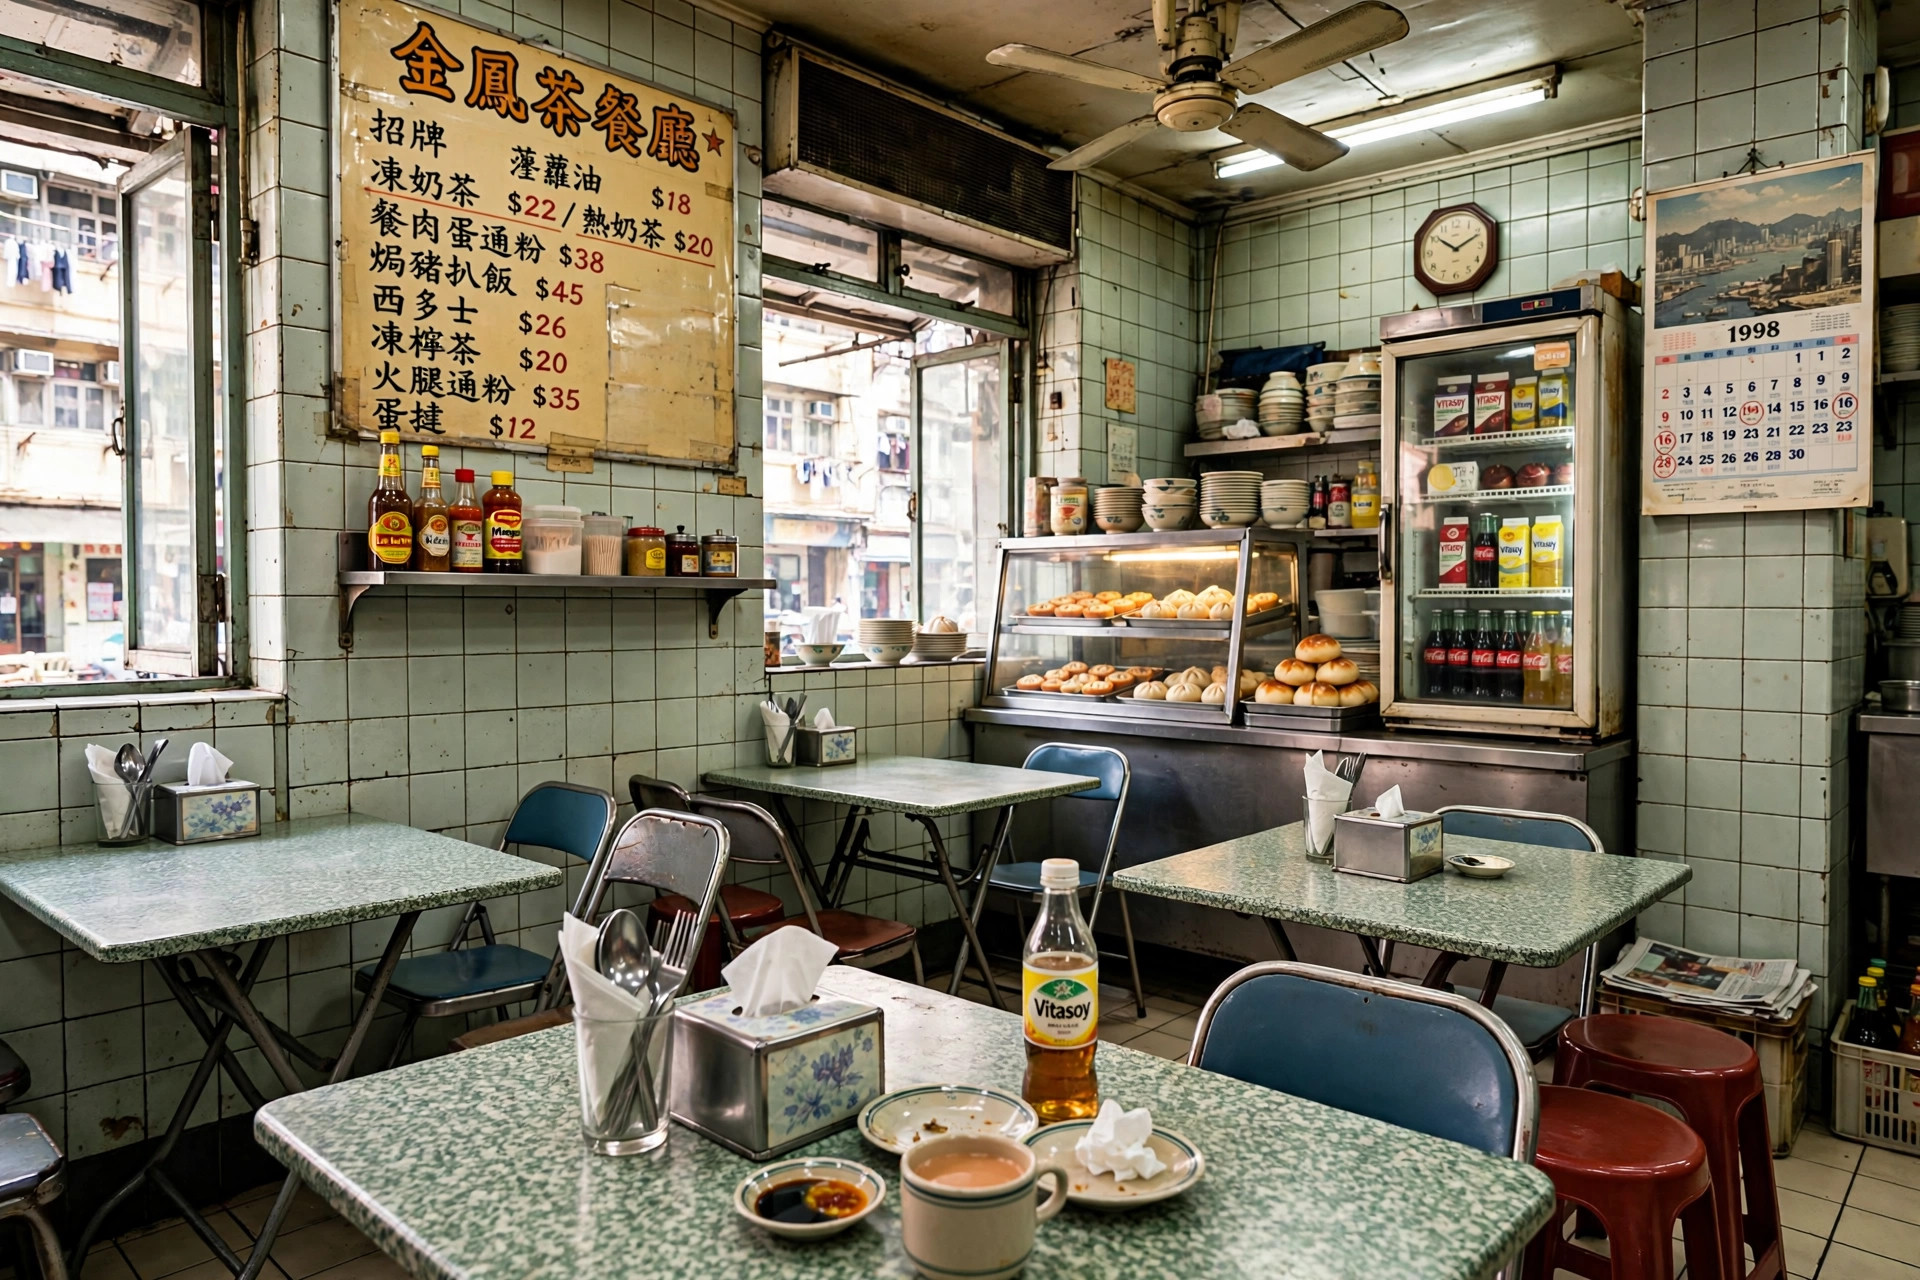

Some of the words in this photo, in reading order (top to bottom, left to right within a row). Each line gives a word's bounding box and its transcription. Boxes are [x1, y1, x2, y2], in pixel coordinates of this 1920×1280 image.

[390, 20, 700, 173] 金鳳茶餐廳
[369, 108, 447, 159] 招牌
[651, 186, 691, 215] $18
[371, 156, 480, 208] 凍奶茶
[508, 191, 557, 221] $22
[583, 204, 665, 249] 熱奶茶
[674, 230, 713, 258] $20
[370, 198, 546, 264] 餐肉蛋通粉
[559, 244, 604, 274] $38
[1440, 225, 1447, 233] 11
[1451, 220, 1460, 229] 12
[1478, 241, 1484, 250] 3
[1431, 263, 1437, 271] 8
[1465, 265, 1472, 274] 5
[1475, 255, 1480, 263] 4
[369, 242, 518, 297] 焗豬扒飯
[535, 276, 584, 306] $45
[1441, 270, 1447, 279] 7
[1453, 271, 1460, 279] 6
[373, 284, 478, 325] 西多士
[519, 310, 566, 339] $26
[1727, 320, 1780, 343] 1998
[371, 320, 481, 366] 凍檸茶
[519, 347, 568, 374] $20
[1795, 352, 1801, 363] 1
[1817, 351, 1824, 361] 1
[1842, 347, 1851, 359] 2
[372, 361, 516, 405] 火腿通粉
[533, 385, 580, 411] $35
[1662, 388, 1669, 399] 2
[1683, 387, 1690, 398] 3
[1703, 385, 1712, 396] 4
[1726, 383, 1733, 394] 5
[1748, 381, 1756, 392] 6
[1771, 379, 1778, 391] 7
[1793, 377, 1802, 388] 8
[1817, 374, 1825, 385] 9
[1841, 372, 1850, 383] 9
[1662, 411, 1669, 422] 9
[1680, 410, 1694, 420] 10
[1701, 408, 1713, 419] 11
[1723, 406, 1737, 417] 12
[1767, 402, 1781, 414] 14
[1790, 401, 1804, 412] 15
[1814, 399, 1828, 410] 16
[1838, 397, 1853, 408] 16
[489, 414, 536, 439] $12
[1659, 434, 1672, 445] 16
[1680, 433, 1693, 443] 17
[1701, 431, 1714, 442] 18
[1723, 429, 1736, 440] 19
[1743, 428, 1759, 439] 23
[1767, 427, 1780, 438] 21
[1789, 425, 1805, 435] 22
[1812, 423, 1828, 434] 23
[1836, 421, 1852, 432] 23
[1678, 455, 1693, 466] 24
[1699, 454, 1714, 465] 25
[1721, 453, 1736, 464] 26
[1743, 452, 1759, 462] 26
[1765, 450, 1781, 461] 28
[1789, 449, 1805, 460] 30
[1034, 997, 1091, 1021] Vitasoy
